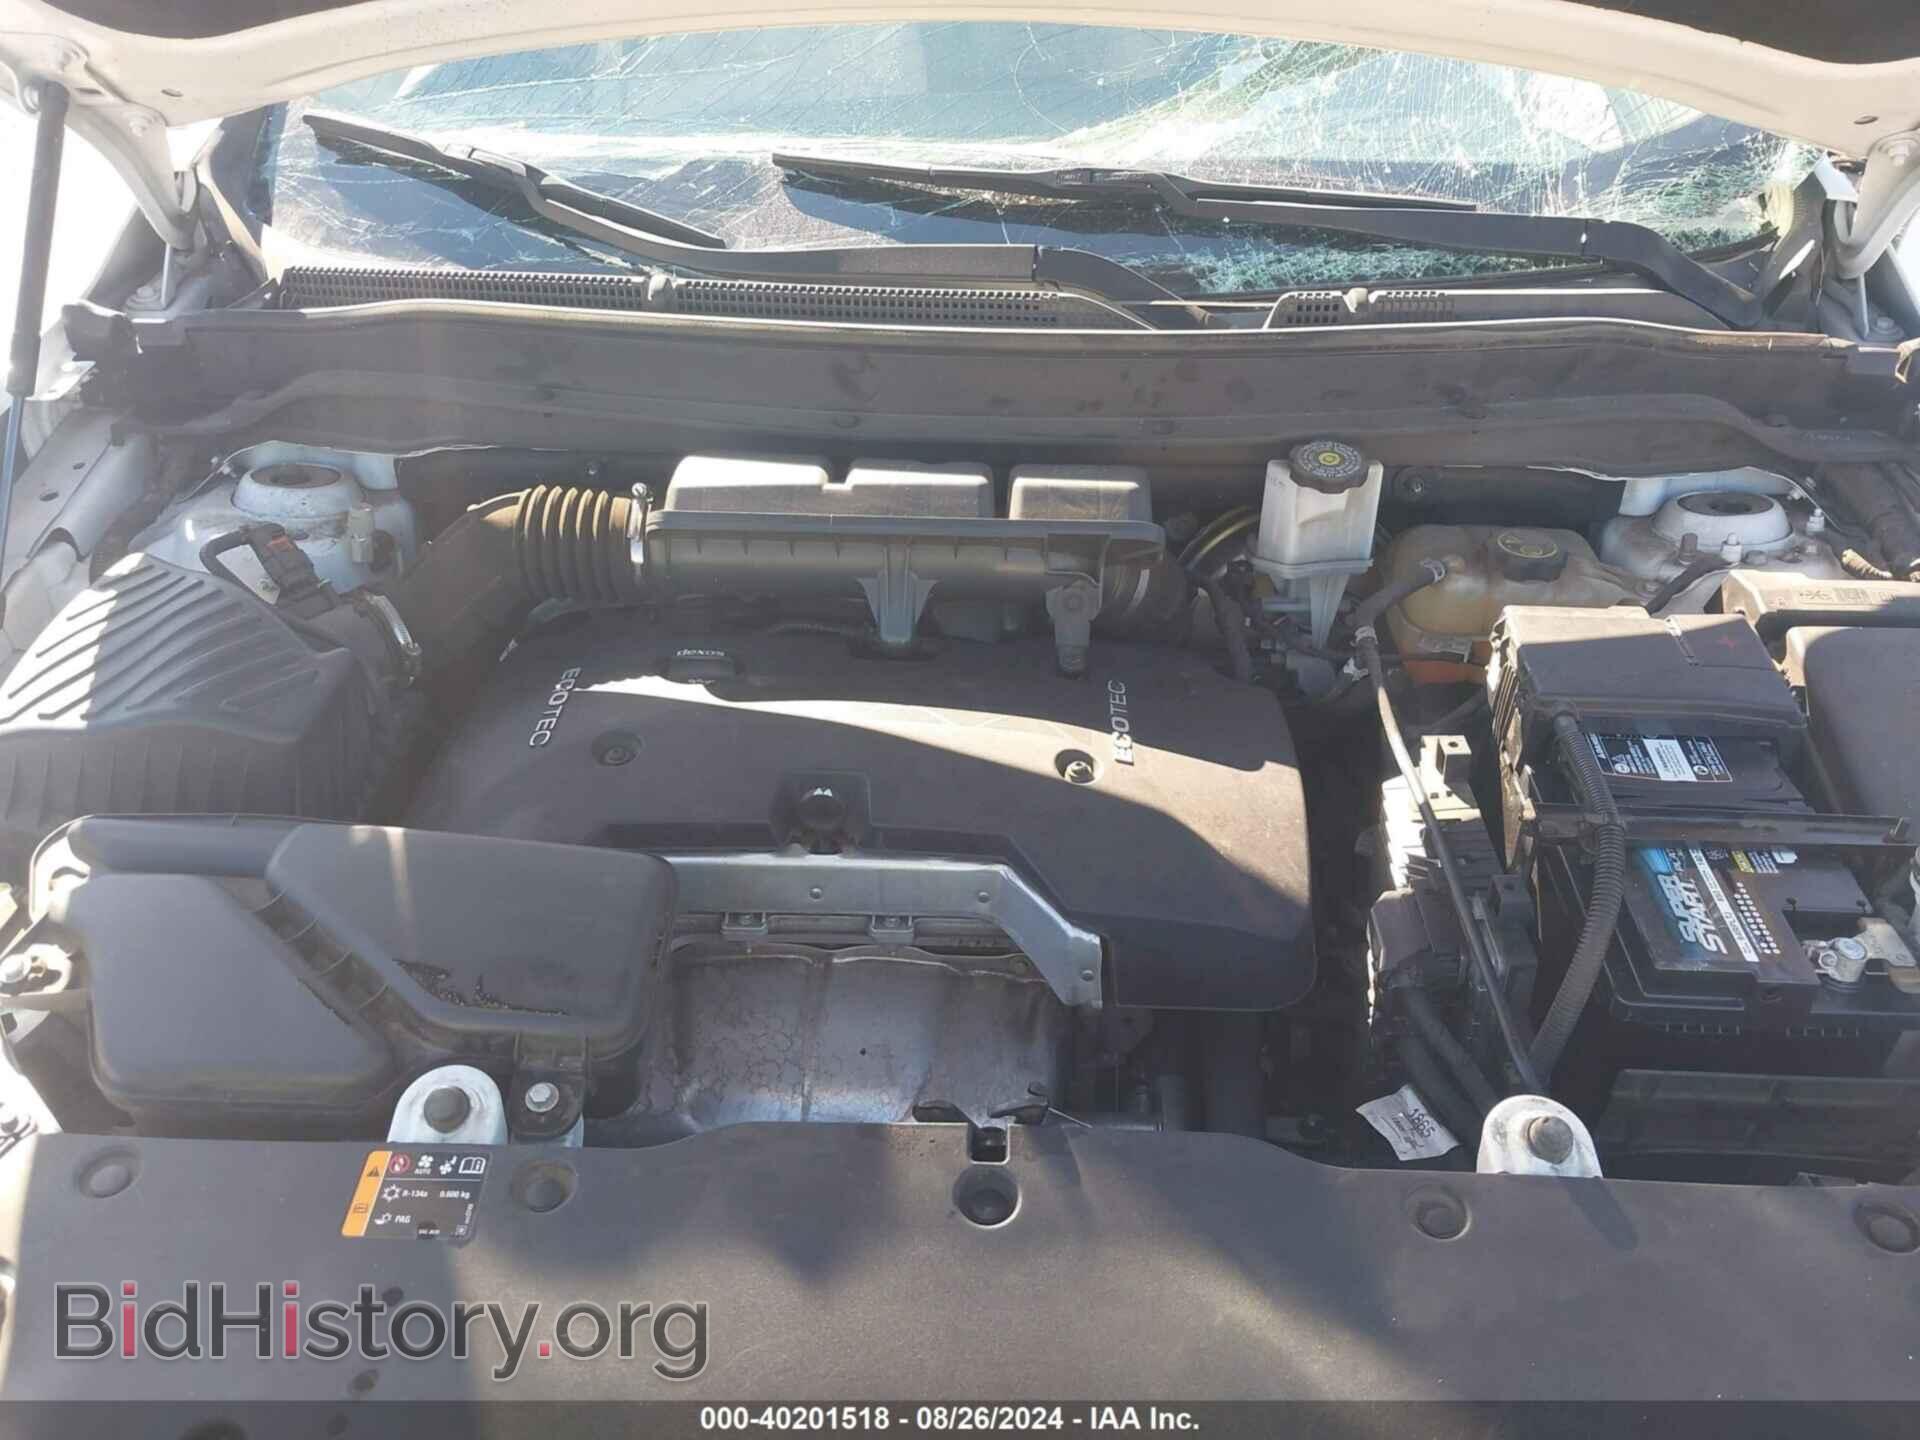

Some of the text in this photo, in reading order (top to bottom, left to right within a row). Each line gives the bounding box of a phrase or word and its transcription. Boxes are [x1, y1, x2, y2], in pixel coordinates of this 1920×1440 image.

[529, 667, 581, 746] ECOTEC
[1107, 680, 1135, 765] ECOTEC
[1657, 874, 1698, 943] SUPER
